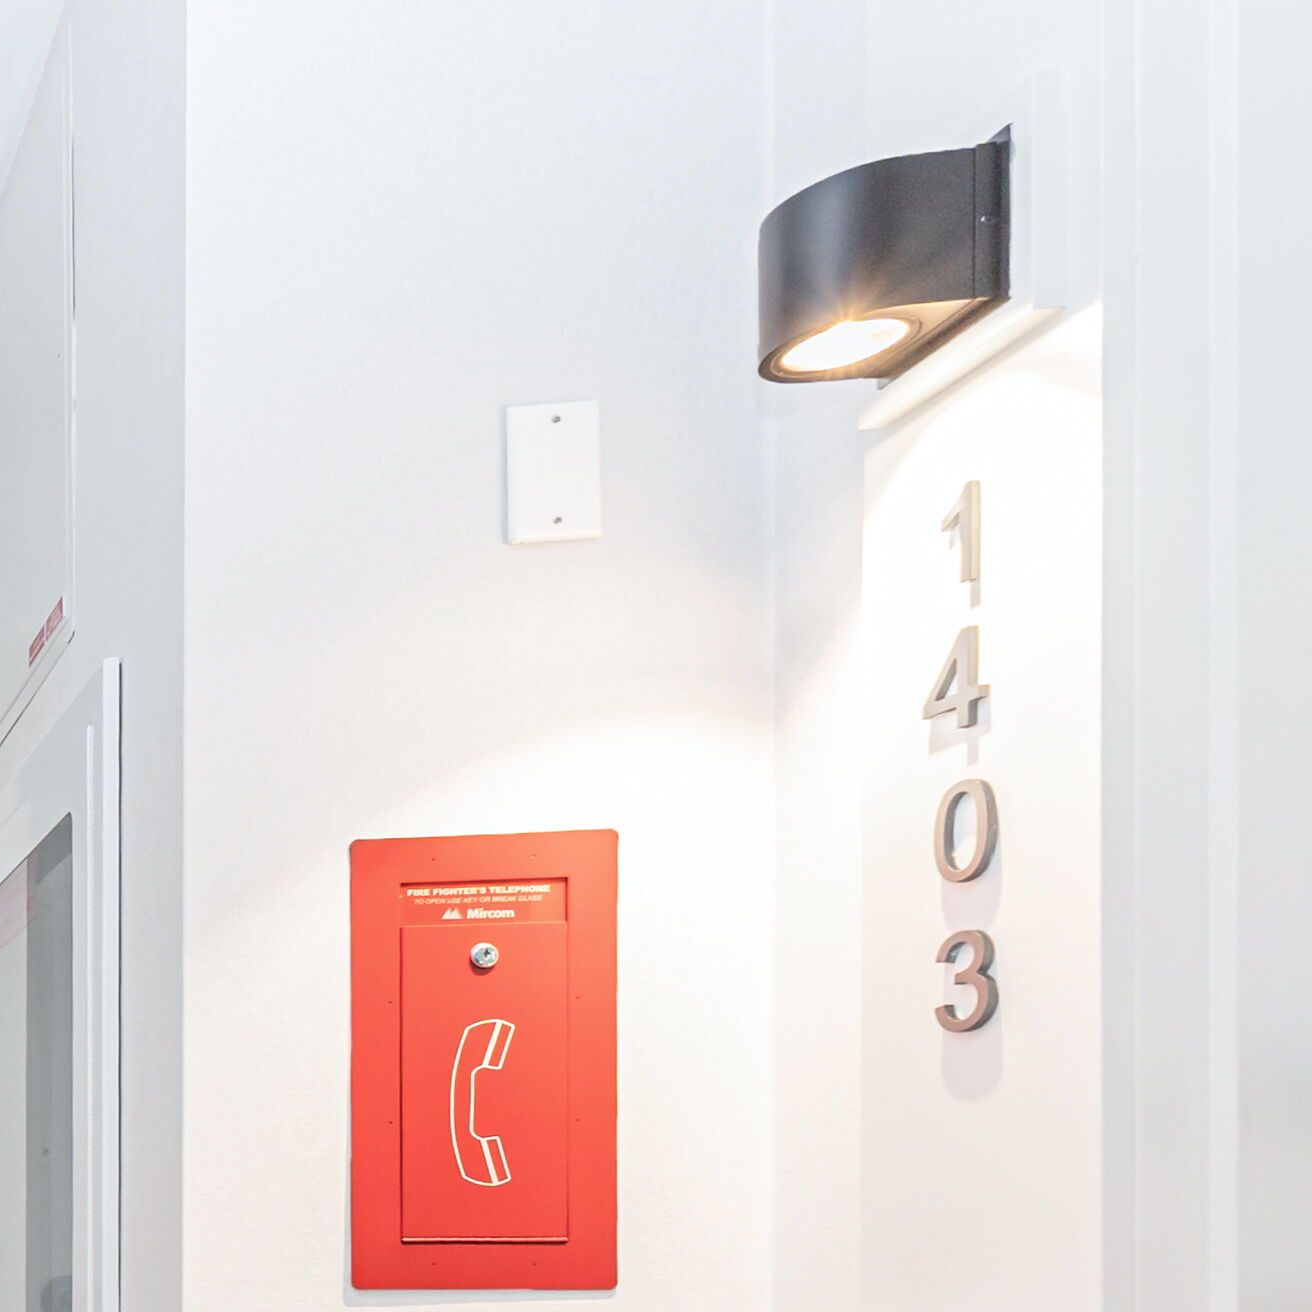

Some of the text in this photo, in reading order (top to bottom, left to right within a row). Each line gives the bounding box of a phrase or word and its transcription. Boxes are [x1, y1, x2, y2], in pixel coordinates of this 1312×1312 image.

[922, 479, 1000, 1033] 1403
[407, 884, 551, 896] FIRE FIGHTER'S TELEPHONE
[466, 907, 515, 919] Mircom
